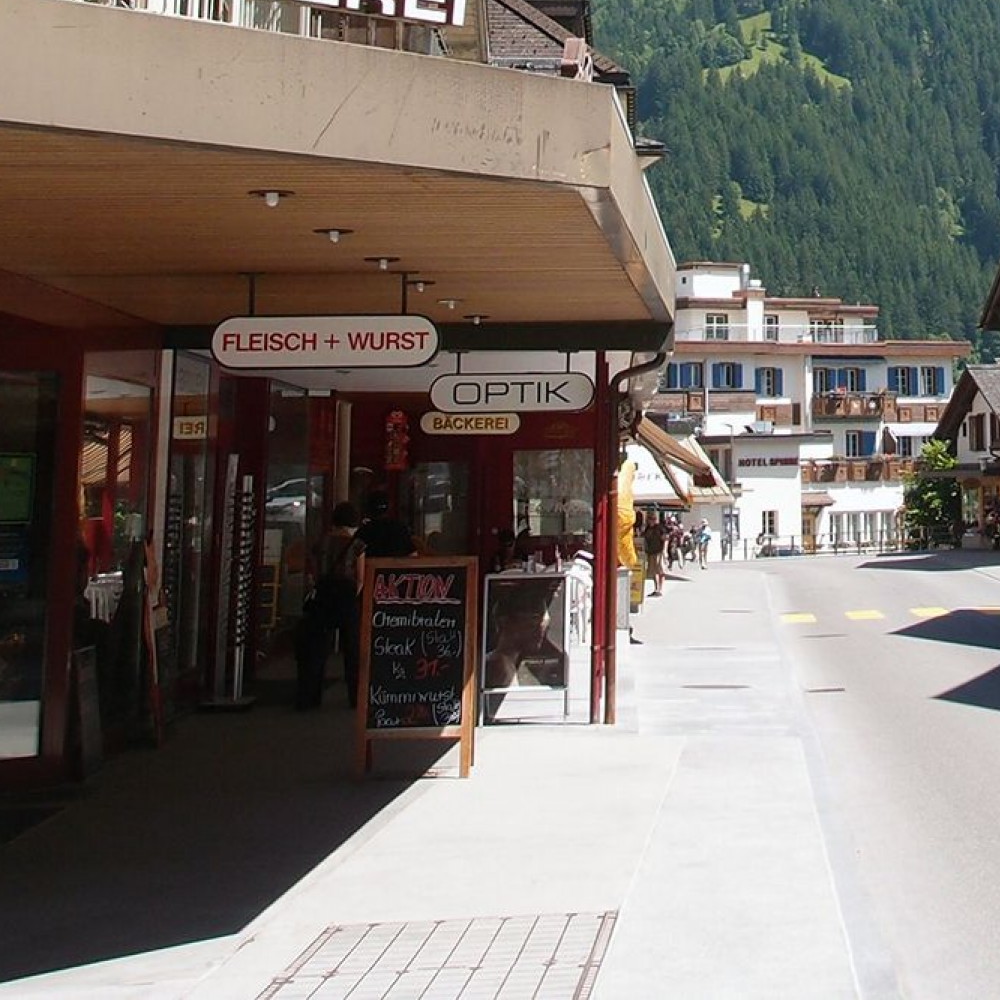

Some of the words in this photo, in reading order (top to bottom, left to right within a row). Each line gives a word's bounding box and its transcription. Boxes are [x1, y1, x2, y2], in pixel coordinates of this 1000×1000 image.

[222, 333, 317, 351] FLEISCH
[324, 334, 340, 350] +
[348, 332, 430, 350] WURST
[452, 381, 570, 405] OPTIK
[433, 416, 509, 430] BÄCKEREI
[738, 457, 768, 467] HOTEL
[374, 573, 455, 600] AKTION
[375, 636, 416, 655] Steak
